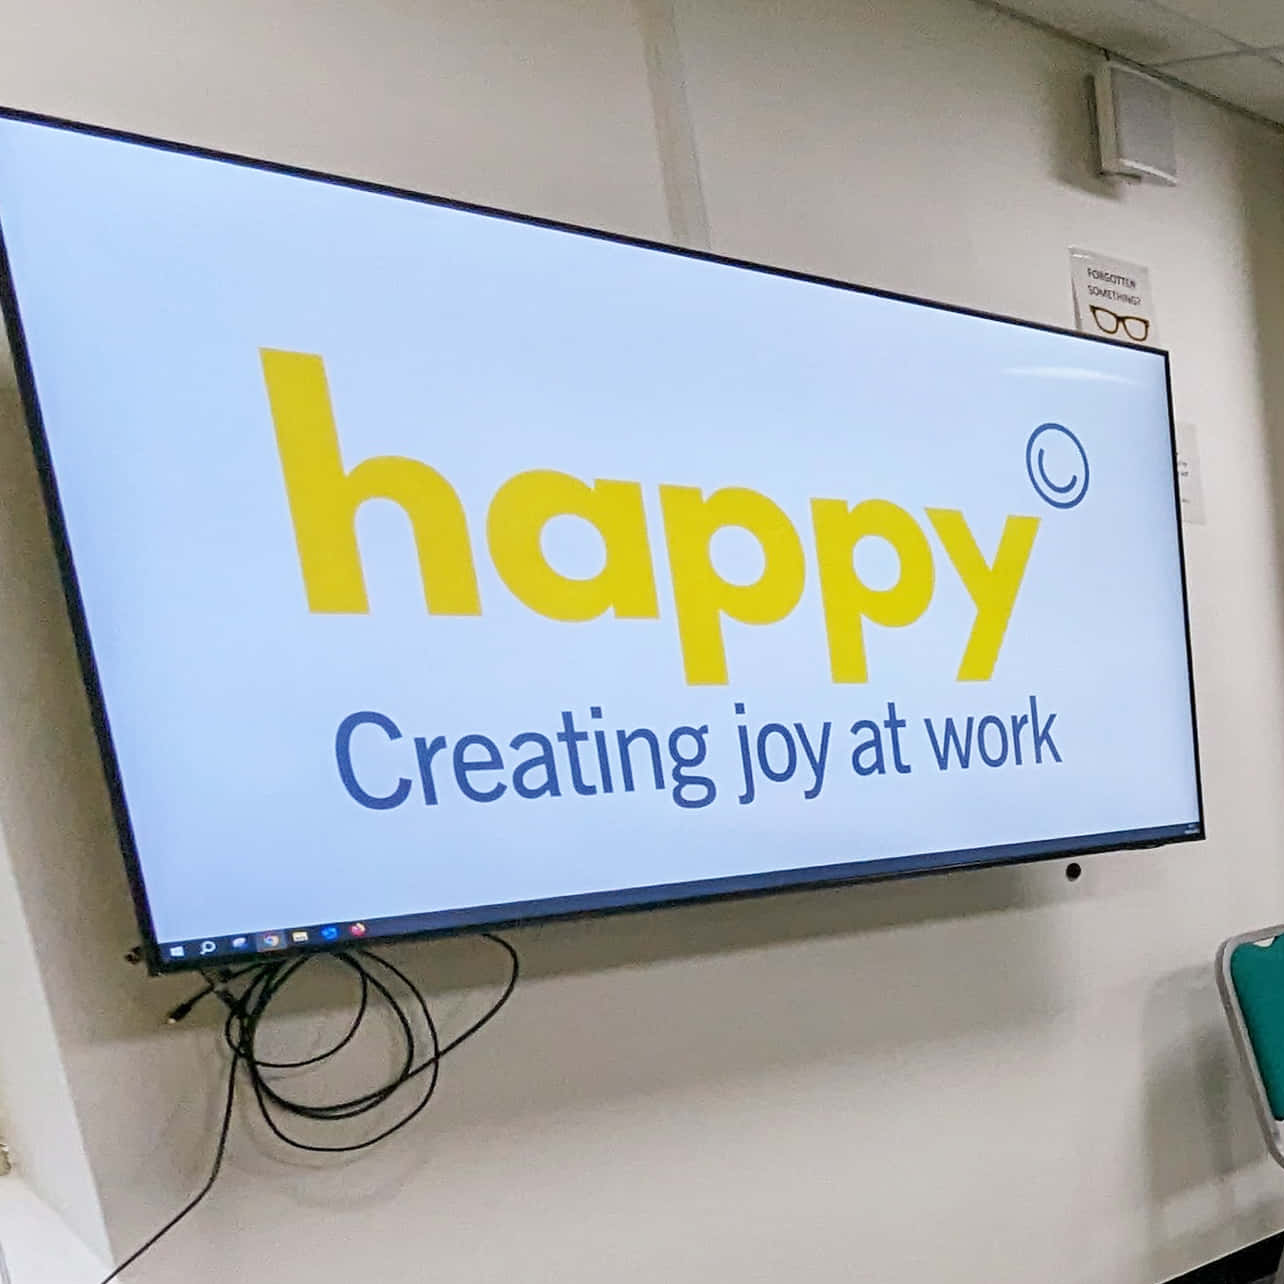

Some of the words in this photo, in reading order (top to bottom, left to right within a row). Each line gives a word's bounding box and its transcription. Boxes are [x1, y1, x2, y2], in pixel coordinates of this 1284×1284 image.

[1087, 268, 1137, 289] FORGOTTEN
[1087, 284, 1142, 306] SOMETHING?
[259, 347, 1041, 685] happy
[335, 706, 717, 812] Creating
[734, 702, 832, 806] joy
[850, 701, 912, 777] at
[924, 695, 1063, 769] work
